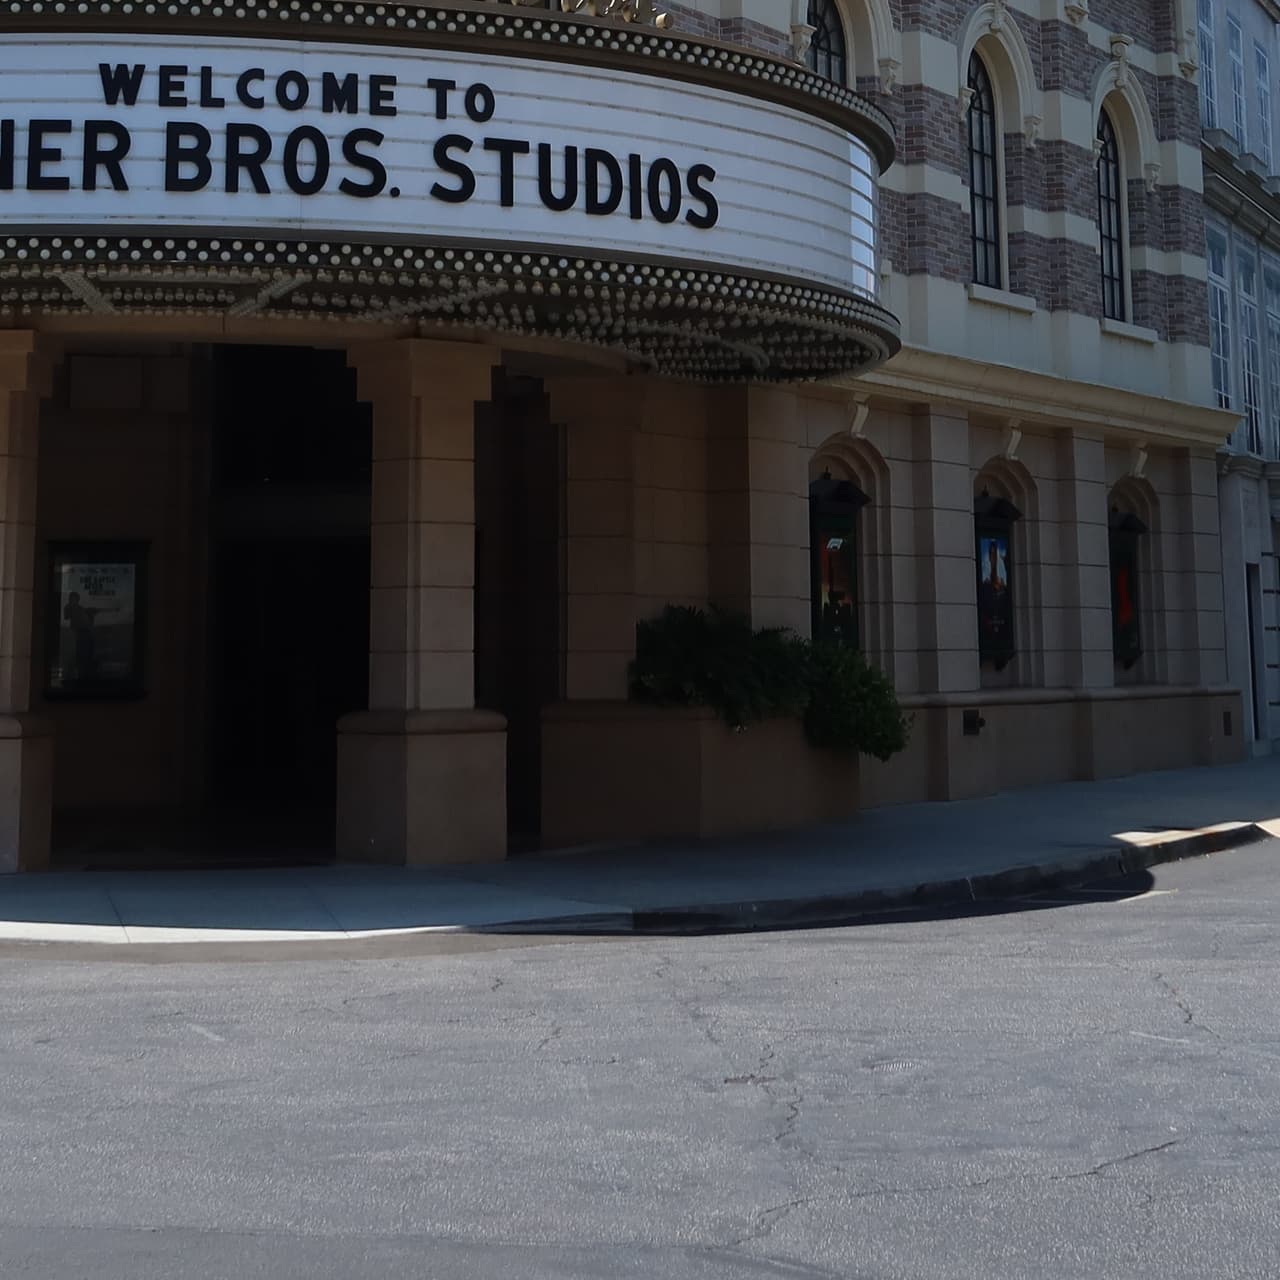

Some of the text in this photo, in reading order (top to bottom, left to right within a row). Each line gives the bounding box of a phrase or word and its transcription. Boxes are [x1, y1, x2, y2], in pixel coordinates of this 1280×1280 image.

[98, 62, 497, 125] WELCOME TO
[158, 120, 402, 200] BROS.
[428, 132, 721, 231] STUDIOS
